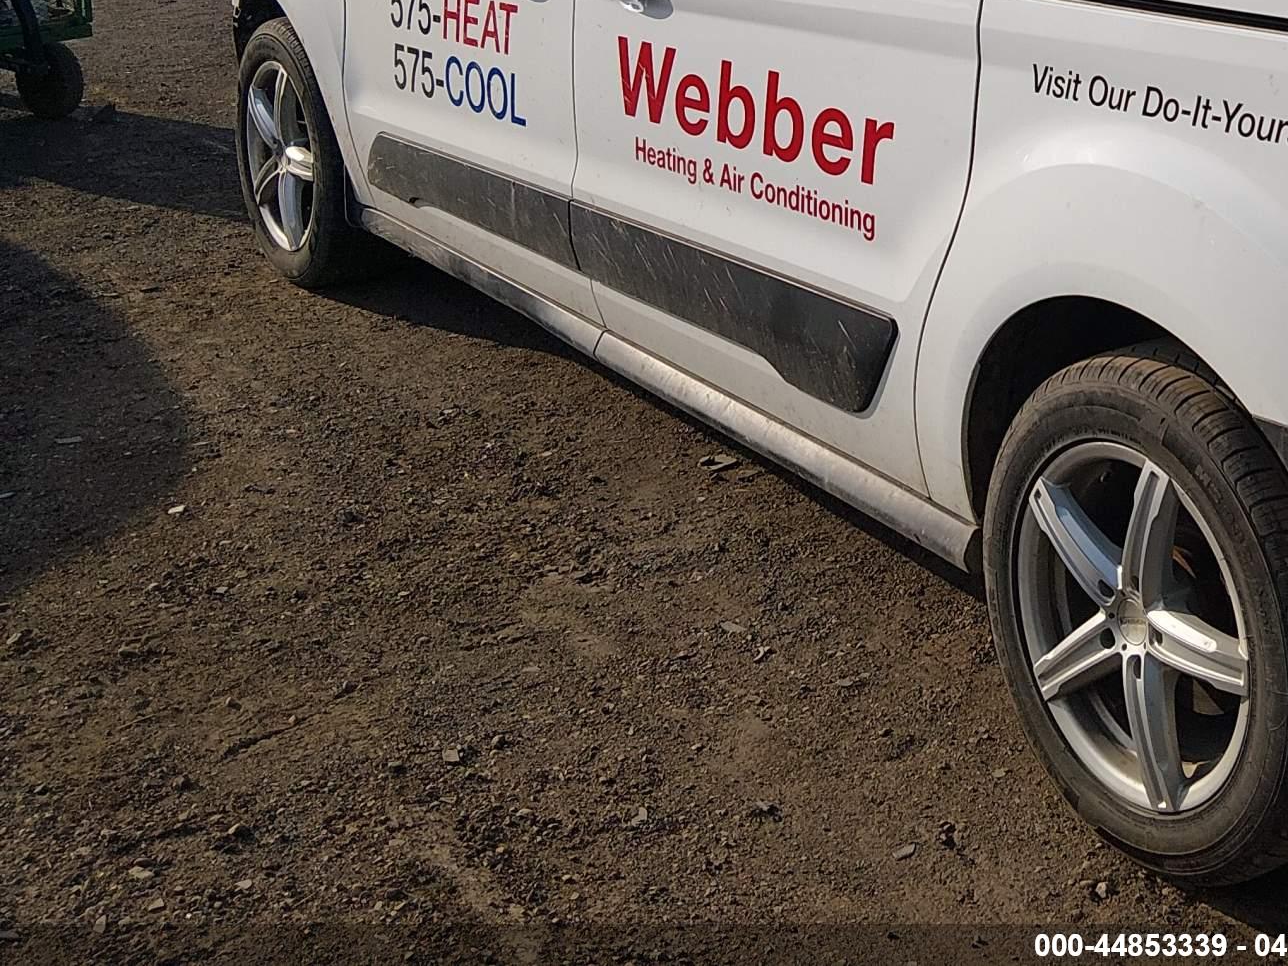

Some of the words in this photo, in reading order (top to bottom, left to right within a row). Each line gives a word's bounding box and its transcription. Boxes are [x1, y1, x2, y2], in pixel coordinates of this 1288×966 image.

[394, 43, 526, 127] 575-COOL
[618, 36, 895, 185] Webber
[1032, 63, 1081, 102] Visit
[1088, 75, 1136, 113] Our
[635, 136, 697, 185] Heating
[703, 158, 715, 185] &
[720, 163, 745, 194] Air
[750, 172, 876, 242] Conditioning
